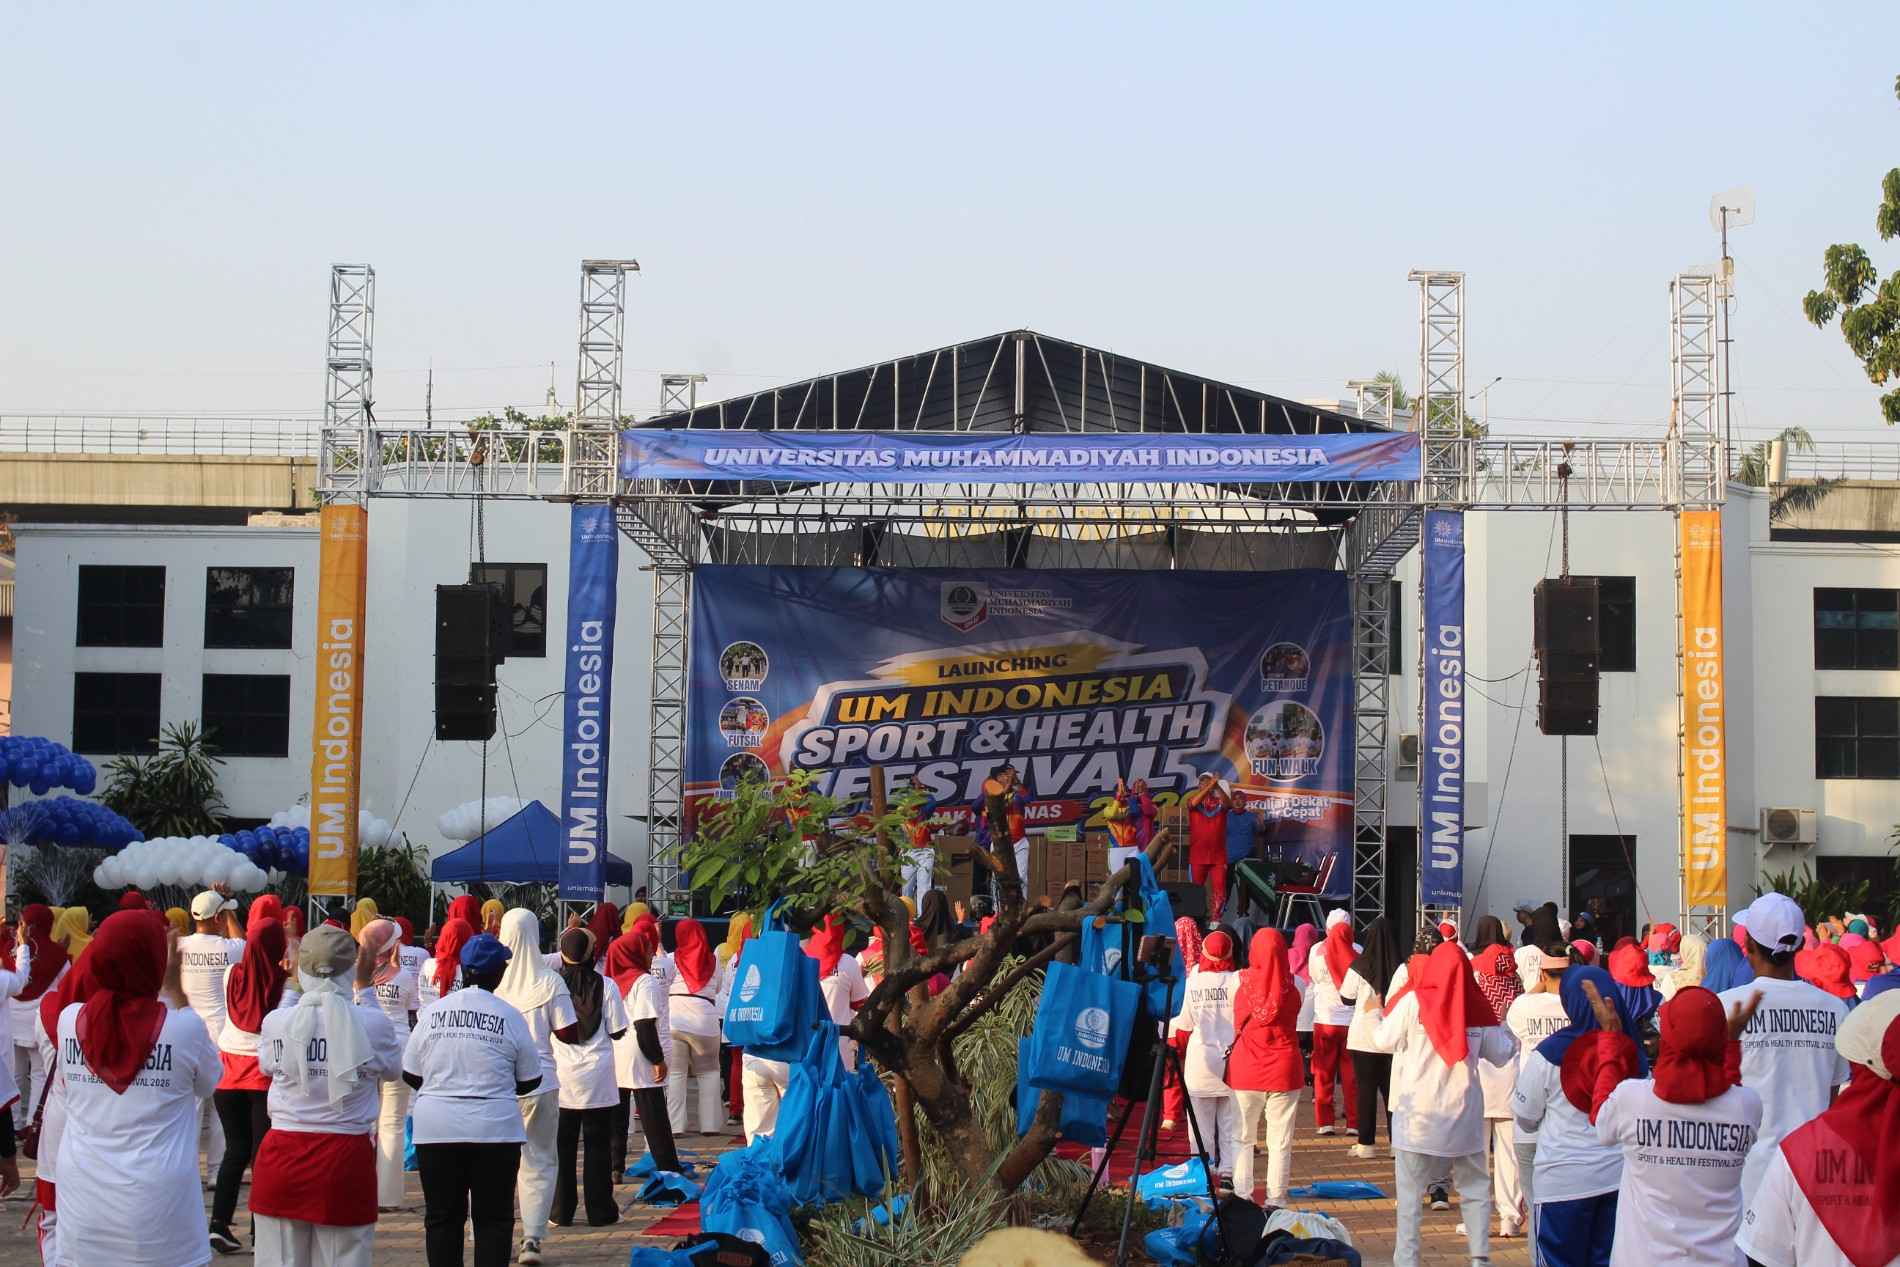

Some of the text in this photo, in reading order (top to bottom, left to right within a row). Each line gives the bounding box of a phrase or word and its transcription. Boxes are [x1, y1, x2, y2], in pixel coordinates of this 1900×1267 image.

[703, 447, 1330, 467] UNIVERSITAS MUHAMMADIYAH INDONESIA
[938, 653, 1068, 678] LAUNCHING
[727, 679, 760, 691] SENAM
[838, 673, 1174, 723] UM INDONESIA
[319, 619, 353, 793] Indonesia
[1687, 626, 1721, 804] Indonesia
[568, 620, 603, 865] UM Indonesia
[798, 703, 1208, 766] SPORT & HEALTH
[1431, 624, 1462, 870] UM Indonesia
[1252, 759, 1317, 775] FUN WALK
[318, 802, 346, 859] UM
[1692, 812, 1720, 870] UM
[184, 951, 230, 966] INDONESIA
[448, 1009, 505, 1036] INDONESIA
[1768, 1008, 1837, 1036] INDONESIA
[150, 1078, 170, 1087] 2026
[1636, 1118, 1751, 1153] UM INDONESIA
[1665, 1156, 1698, 1166] HEALTH
[1698, 1157, 1732, 1168] FESTIVAL
[1815, 1148, 1848, 1184] UM
